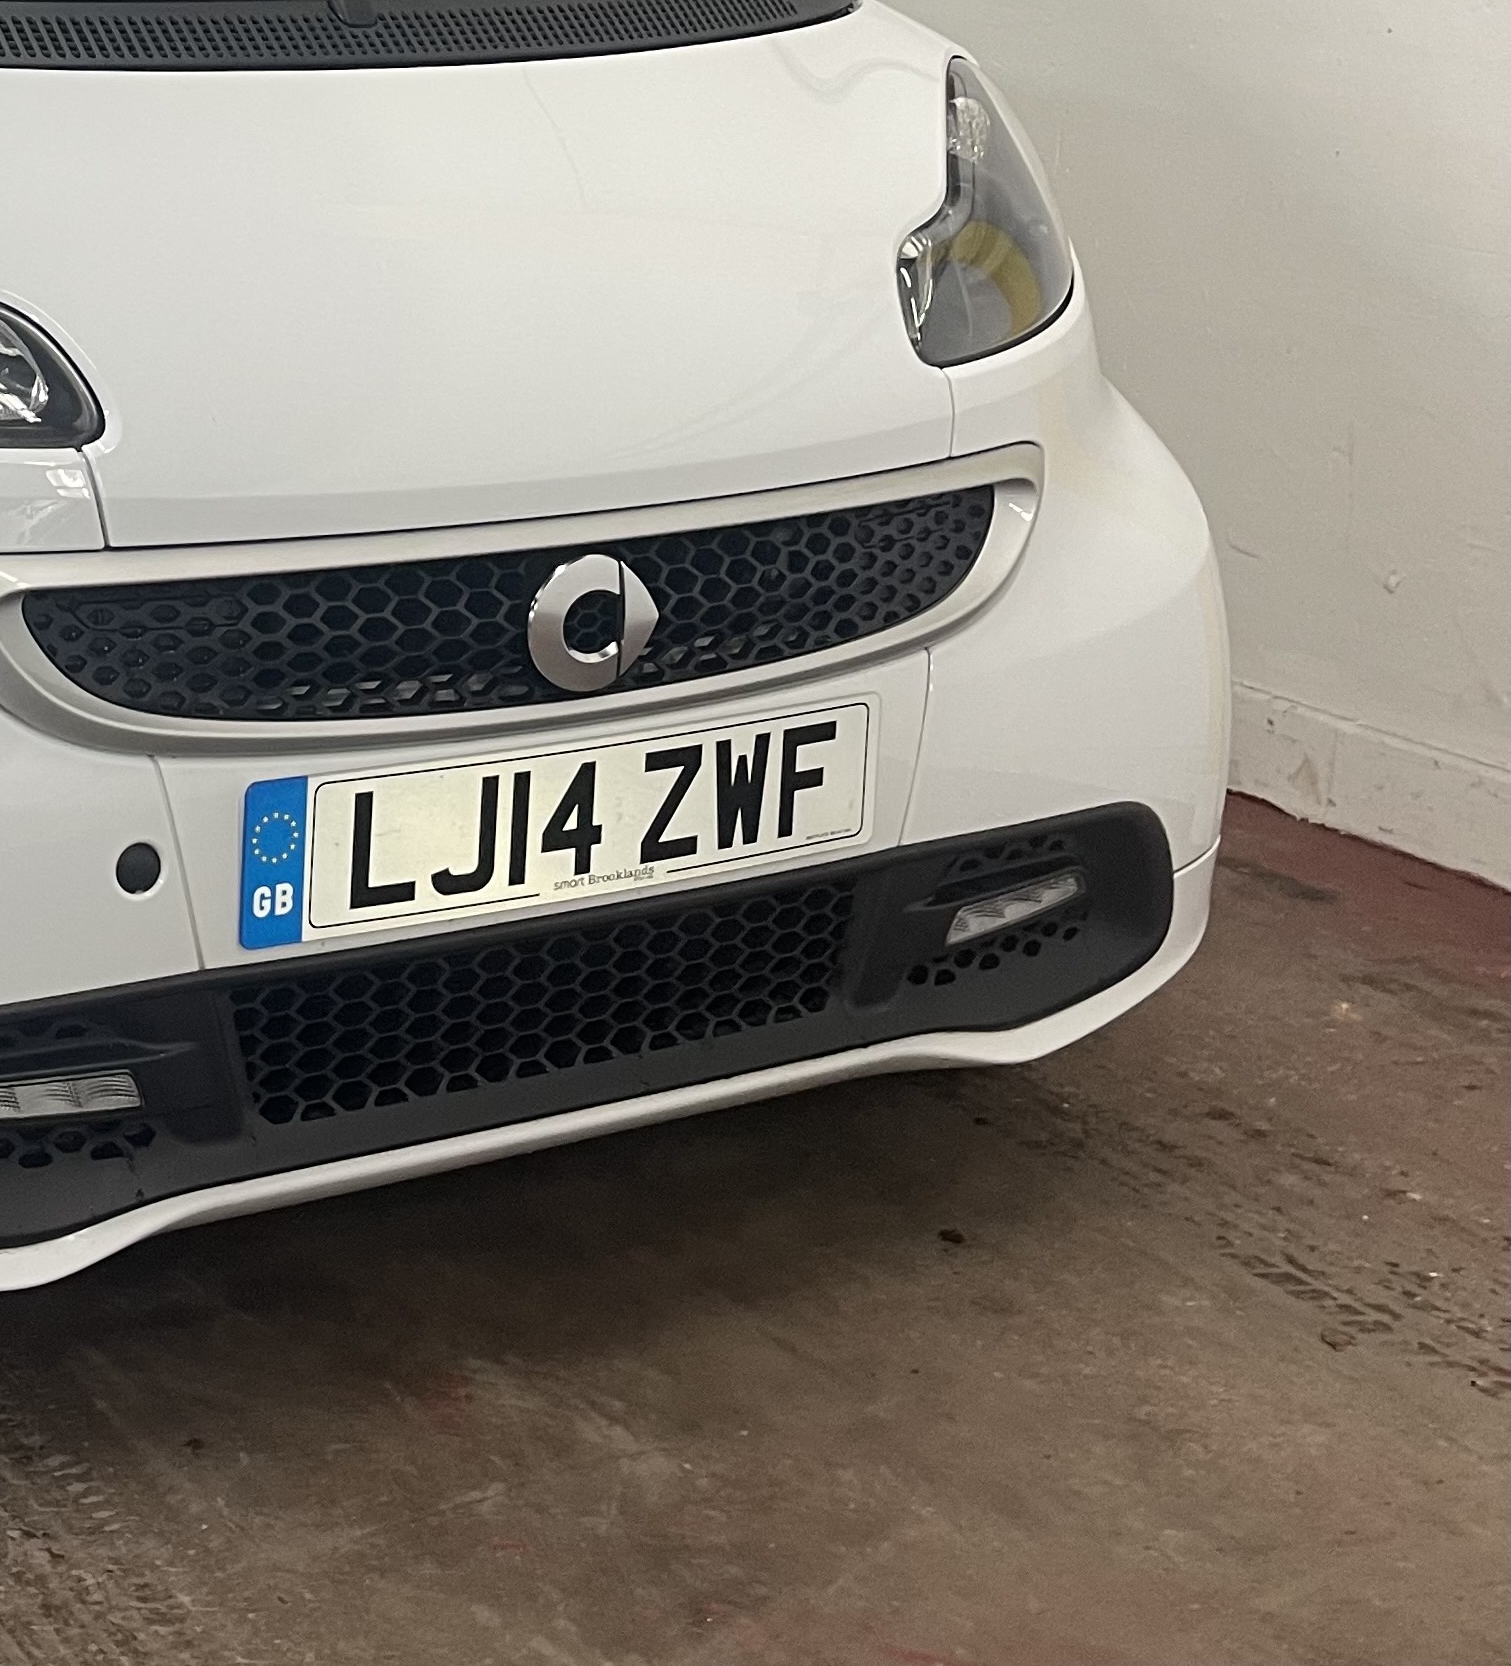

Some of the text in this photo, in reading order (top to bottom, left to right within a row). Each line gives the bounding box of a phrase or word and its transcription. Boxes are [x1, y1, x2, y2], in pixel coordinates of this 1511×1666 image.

[349, 720, 838, 909] LJ14 ZWF
[553, 875, 586, 891] smart
[588, 865, 655, 885] Brooklands
[251, 881, 294, 919] GB
